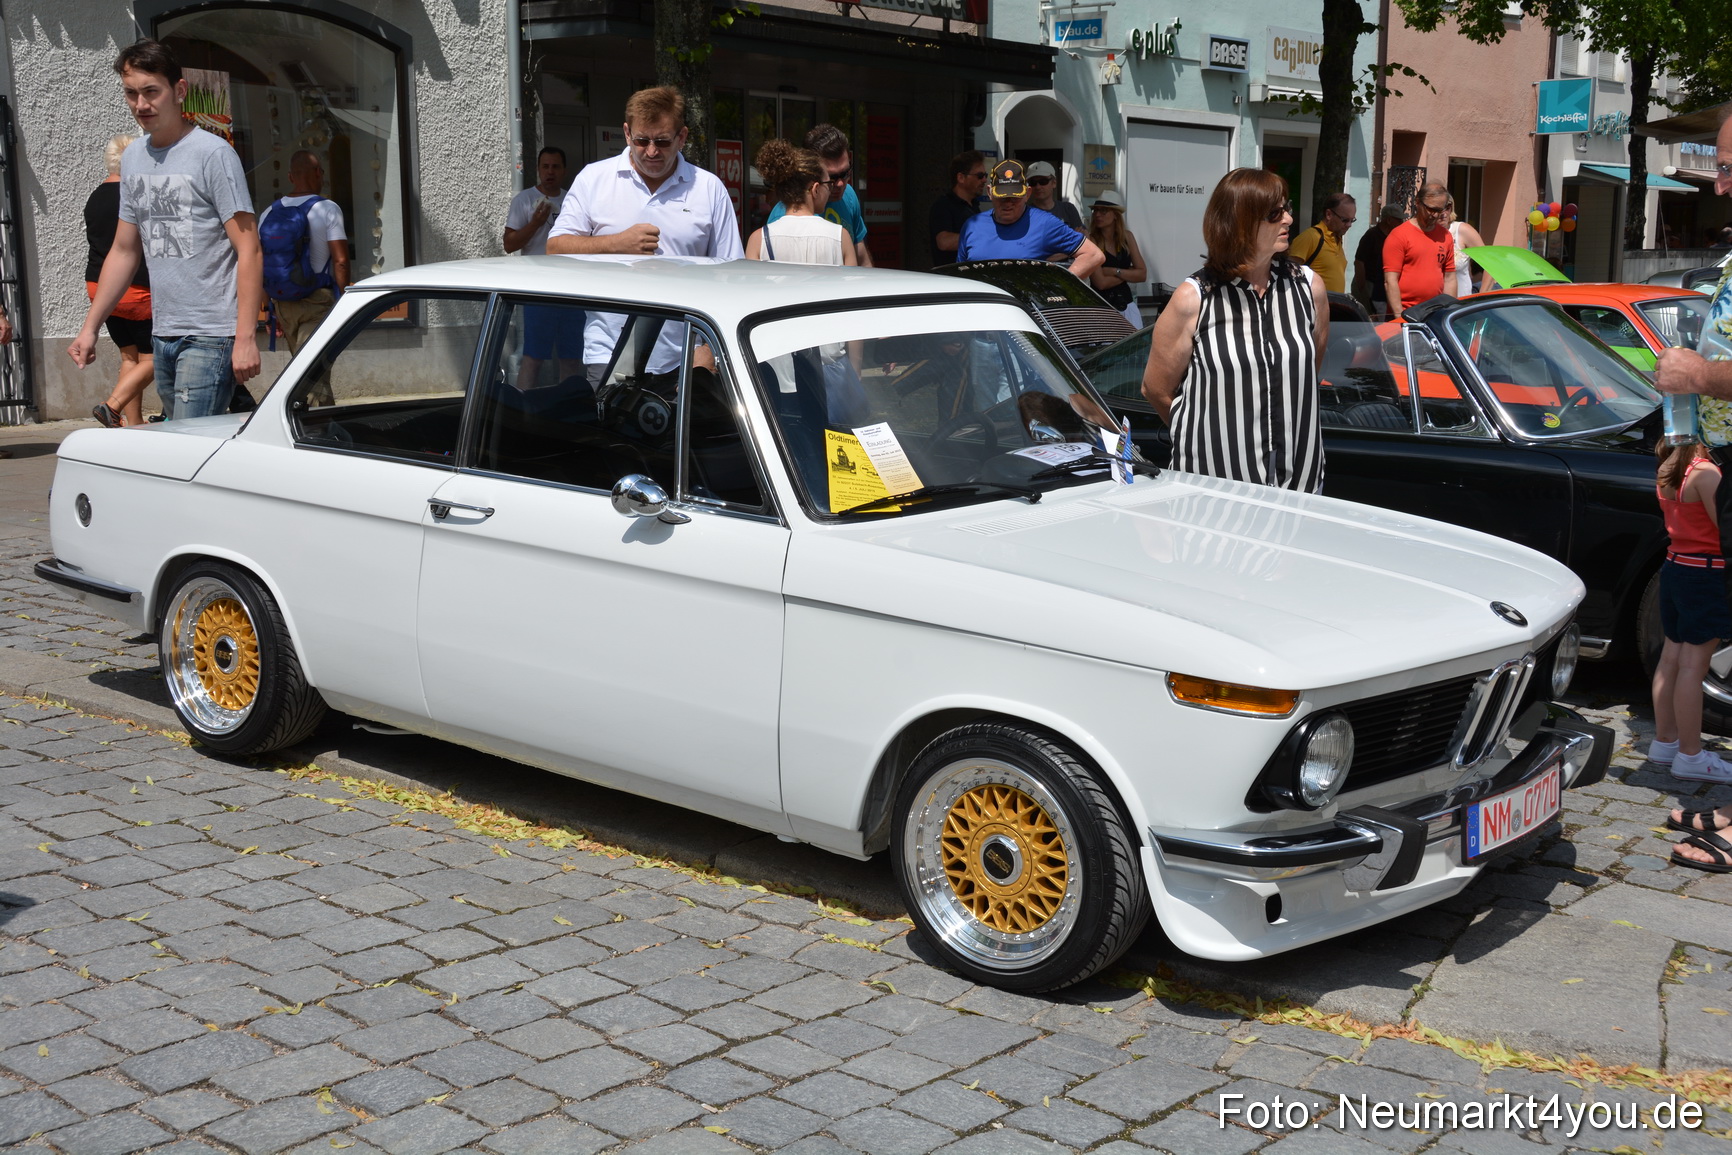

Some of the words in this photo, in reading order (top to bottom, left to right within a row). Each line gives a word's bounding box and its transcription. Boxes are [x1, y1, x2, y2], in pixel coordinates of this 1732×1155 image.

[1058, 23, 1098, 36] blau.de
[1211, 41, 1247, 66] BASE
[1539, 112, 1587, 125] Kochlöffel
[1149, 183, 1160, 192] Wir
[1160, 184, 1176, 194] bauen
[1177, 184, 1185, 194] für
[1185, 185, 1194, 194] Sie
[1194, 186, 1205, 195] um!
[152, 223, 161, 238] 4
[643, 406, 666, 431] 8
[1483, 797, 1511, 846] NM
[1523, 770, 1557, 827] 0770
[1470, 835, 1476, 848] D
